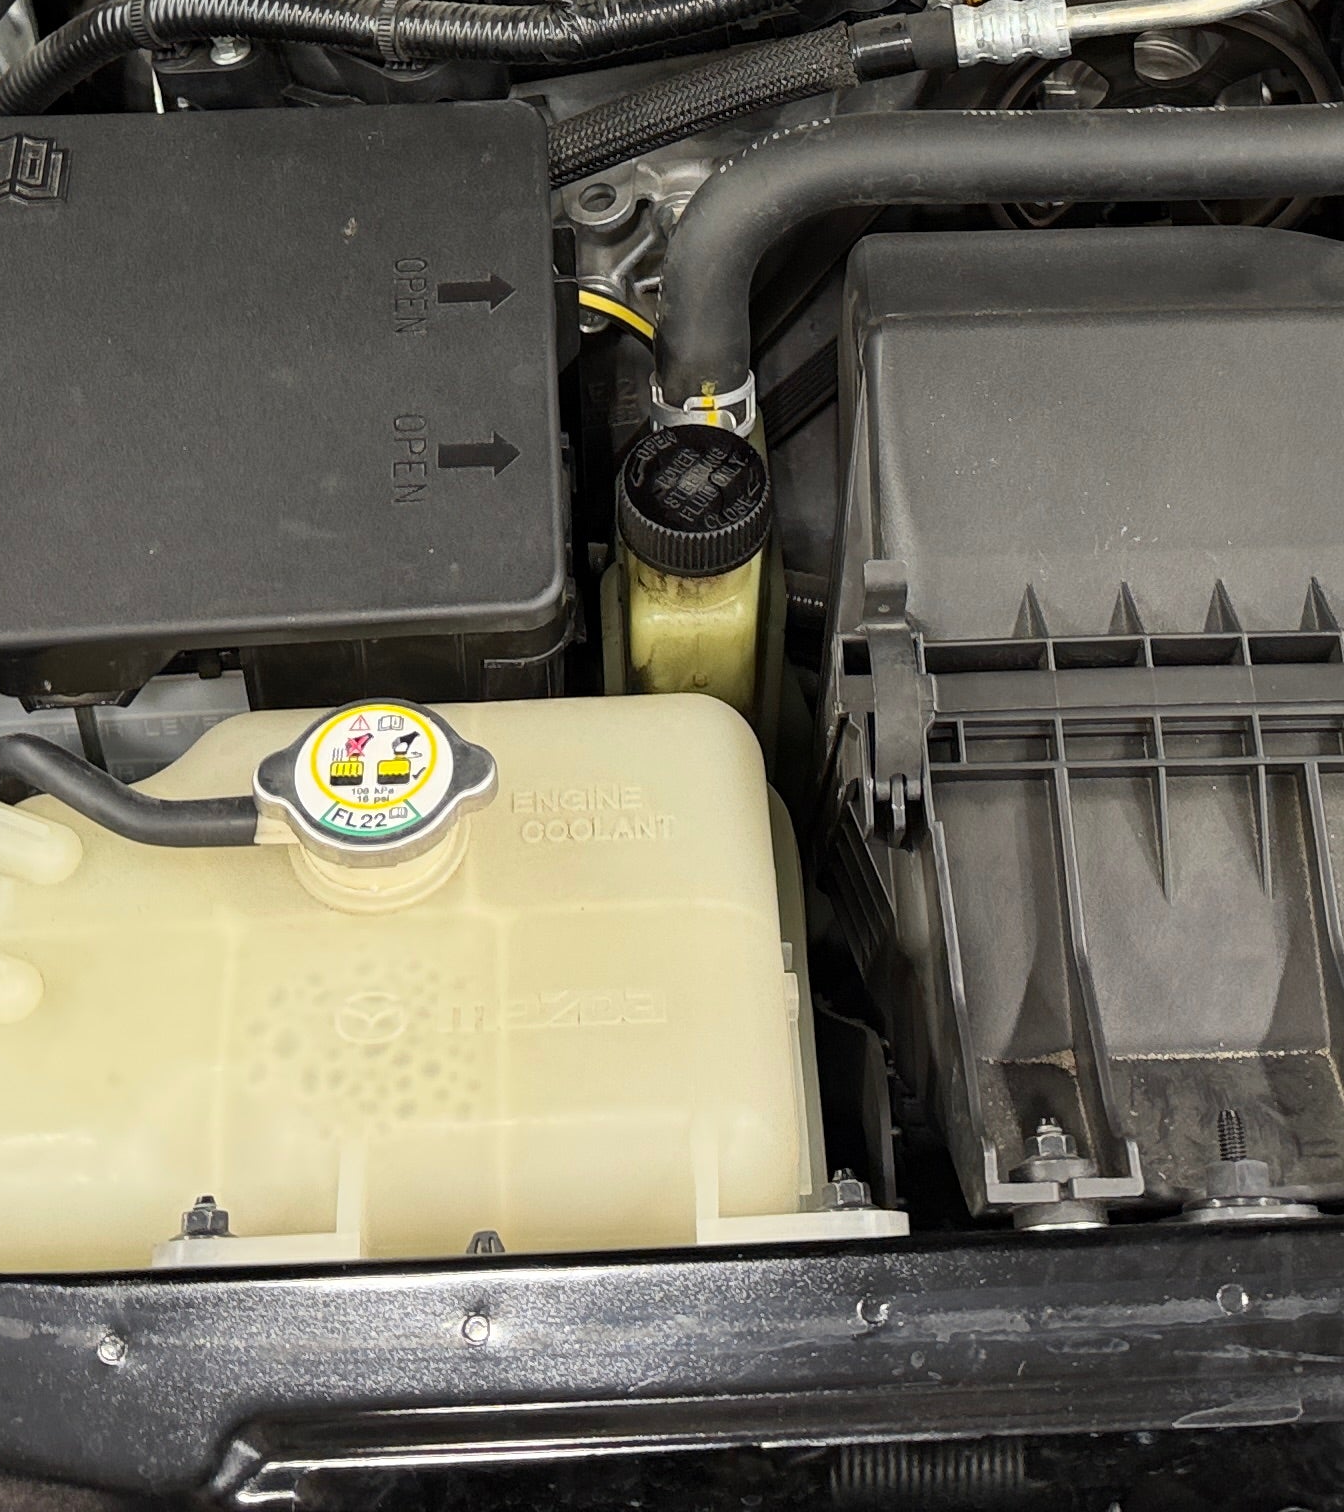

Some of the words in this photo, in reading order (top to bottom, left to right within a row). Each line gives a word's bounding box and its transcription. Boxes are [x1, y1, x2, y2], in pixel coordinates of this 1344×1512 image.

[394, 257, 428, 336] OPEN
[393, 414, 428, 503] OPEN
[636, 429, 678, 461] OPEN
[656, 448, 700, 488] POWER
[664, 448, 728, 509] STEERING
[680, 483, 720, 522] FLUID
[704, 495, 757, 530] CLOSE
[356, 795, 370, 803] 16
[373, 795, 391, 804] psi
[373, 786, 395, 795] kPa
[511, 784, 644, 814] ENGINE
[331, 807, 387, 829] FL22
[520, 815, 676, 844] COOLANT
